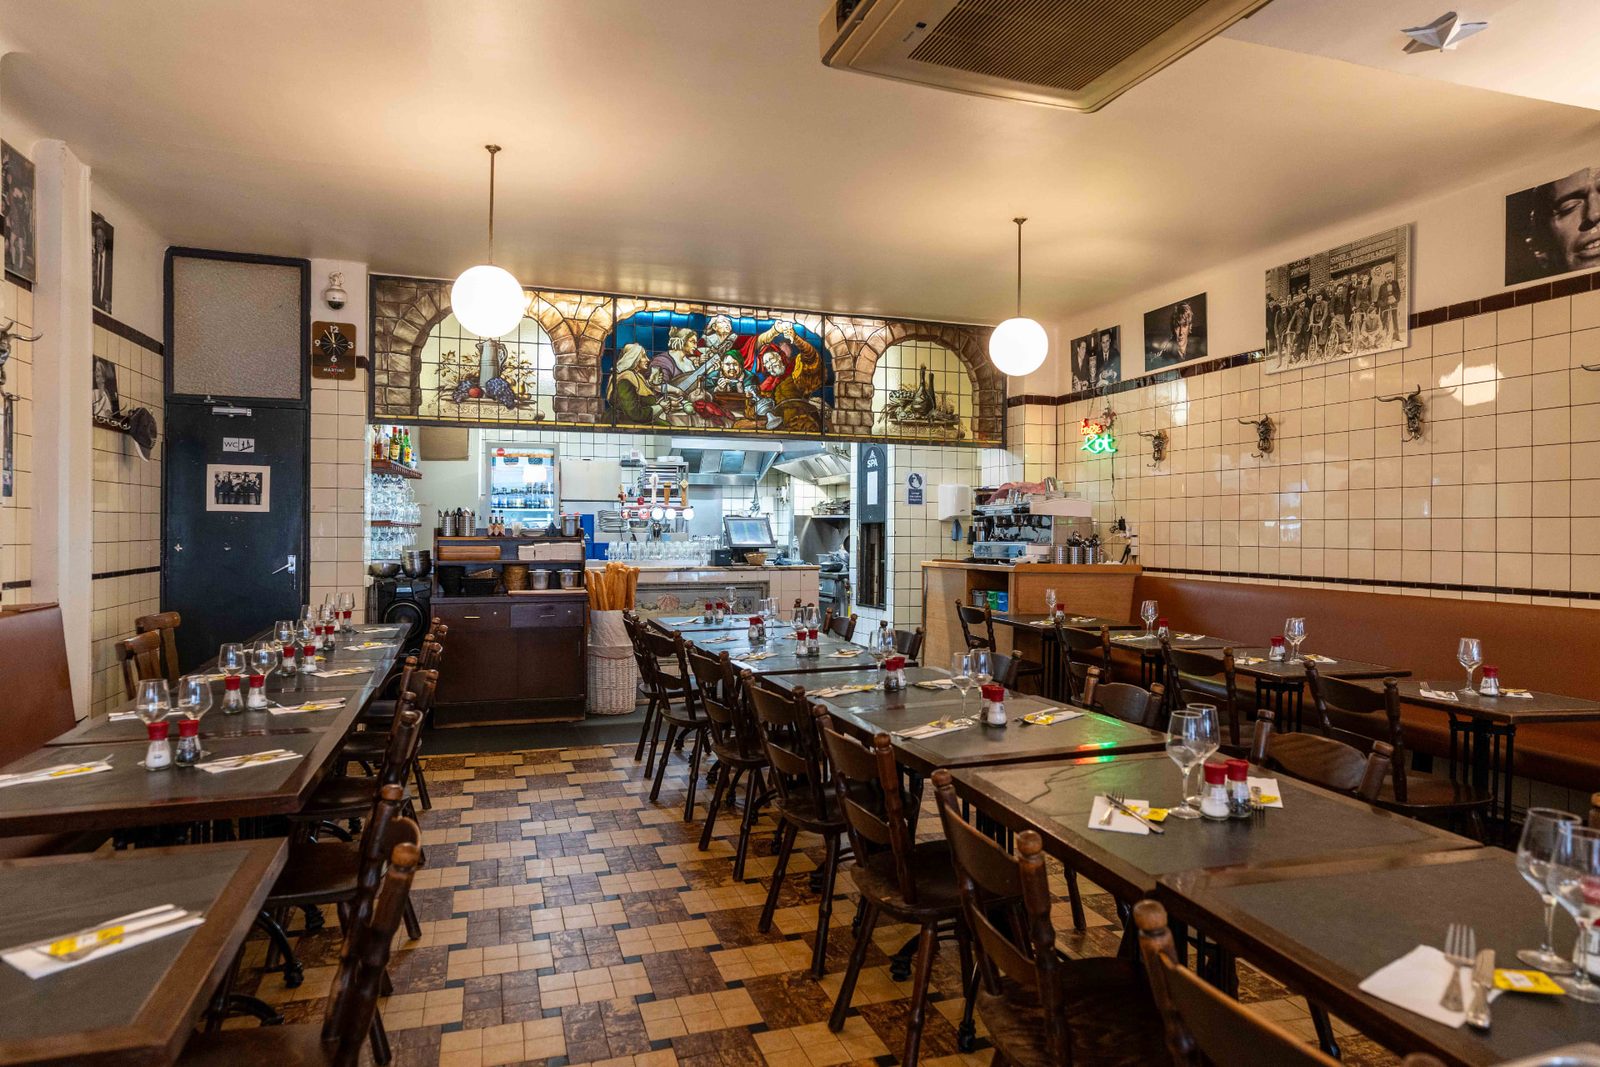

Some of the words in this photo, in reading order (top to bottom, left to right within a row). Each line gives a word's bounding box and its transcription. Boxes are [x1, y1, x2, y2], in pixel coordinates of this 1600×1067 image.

[330, 325, 339, 333] 12
[314, 339, 321, 347] 9
[347, 341, 354, 349] 3
[330, 355, 338, 363] 6
[867, 458, 879, 468] SPA
